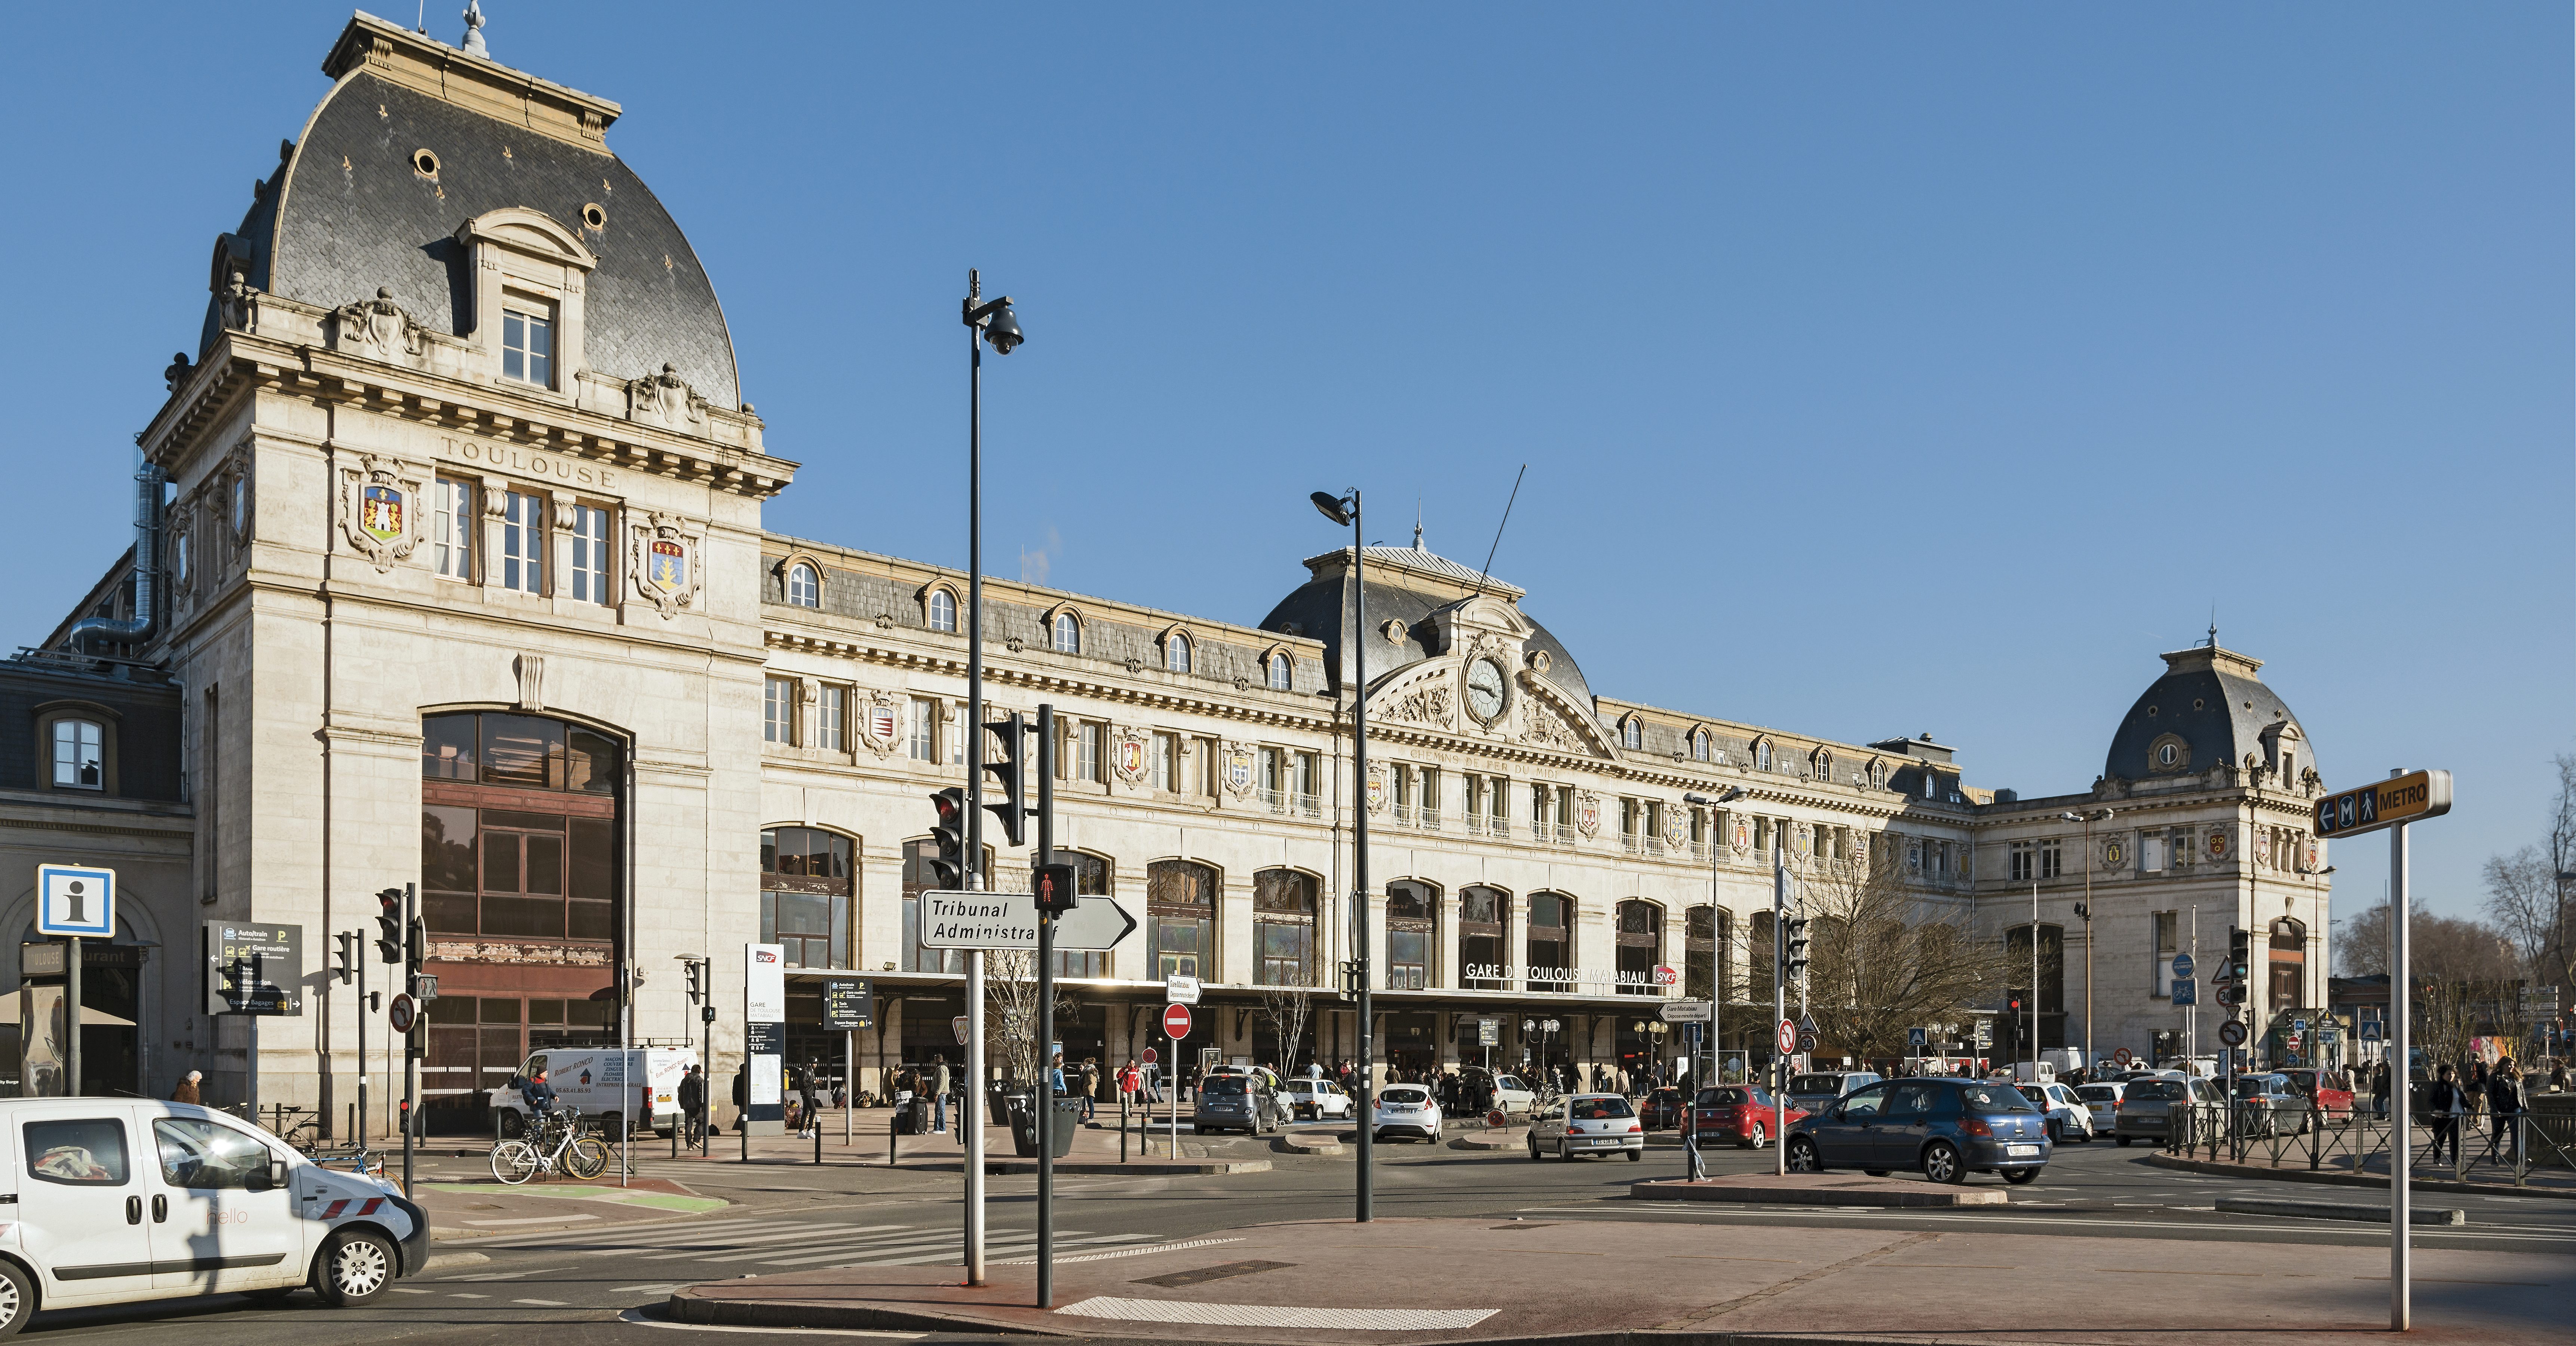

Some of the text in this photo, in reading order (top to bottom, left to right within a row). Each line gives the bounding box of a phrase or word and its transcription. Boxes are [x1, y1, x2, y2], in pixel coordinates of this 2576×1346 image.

[441, 436, 616, 488] TOULOUSE
[1411, 749, 1557, 779] CHEMINS DE FER DU MIDI
[2379, 783, 2427, 811] METRO
[2271, 814, 2303, 826] TOULOUSE
[933, 900, 1008, 917] Tribunal
[933, 923, 1058, 940] Administraf
[83, 951, 125, 962] urant
[1466, 963, 1645, 984] GARE DE TOULOUSE MATABIAU
[1656, 973, 1677, 982] SNCF
[554, 1056, 593, 1077] ROBERT RONCO
[207, 1208, 248, 1224] hello
